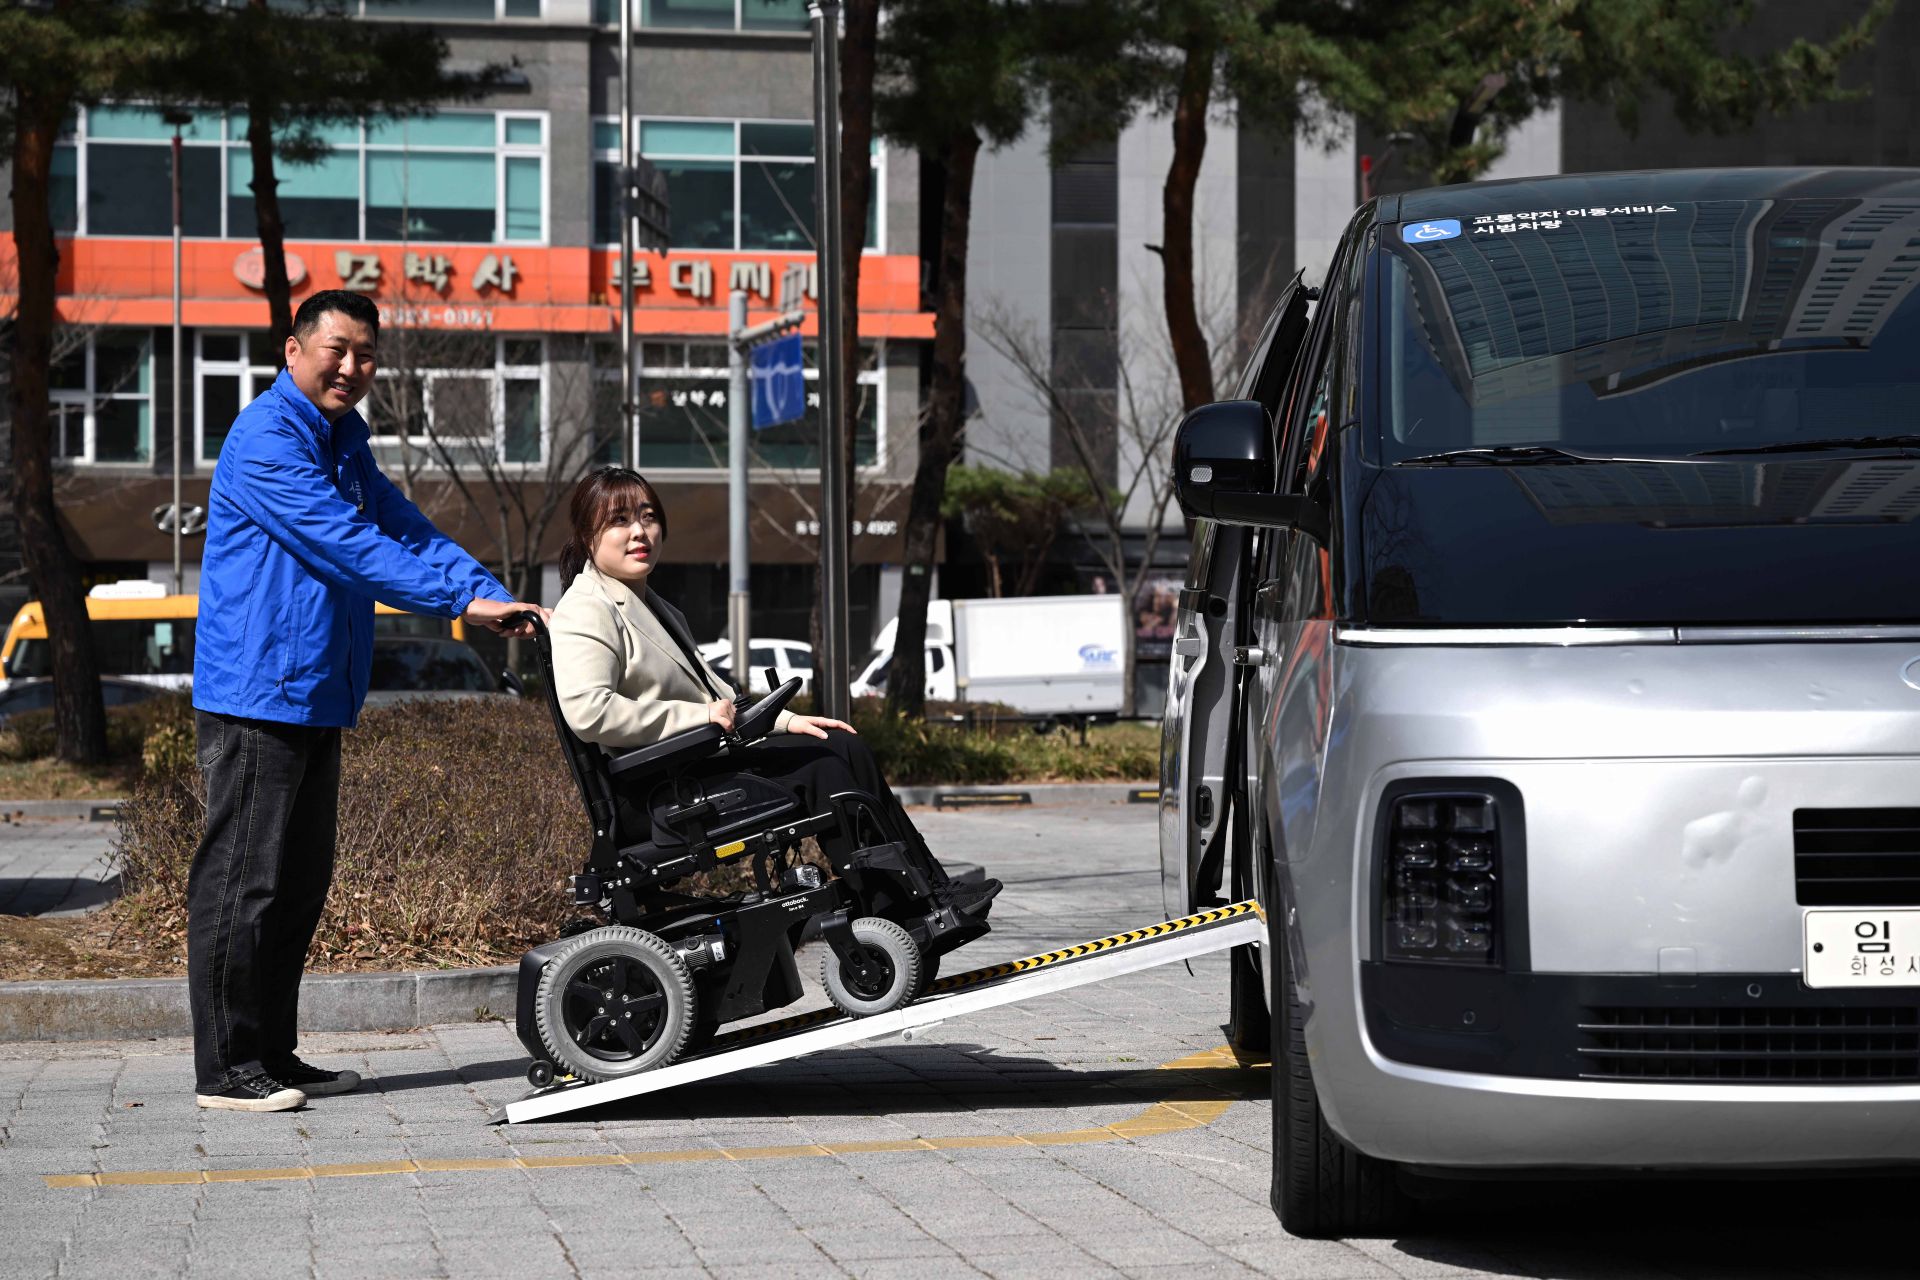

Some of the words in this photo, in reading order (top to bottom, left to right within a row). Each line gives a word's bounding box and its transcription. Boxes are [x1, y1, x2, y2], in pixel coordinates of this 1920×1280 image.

[1473, 210, 1561, 225] 교통약자
[1566, 205, 1677, 217] 이동서비스
[1474, 220, 1562, 234] 시범차량
[1854, 920, 1890, 953] 임
